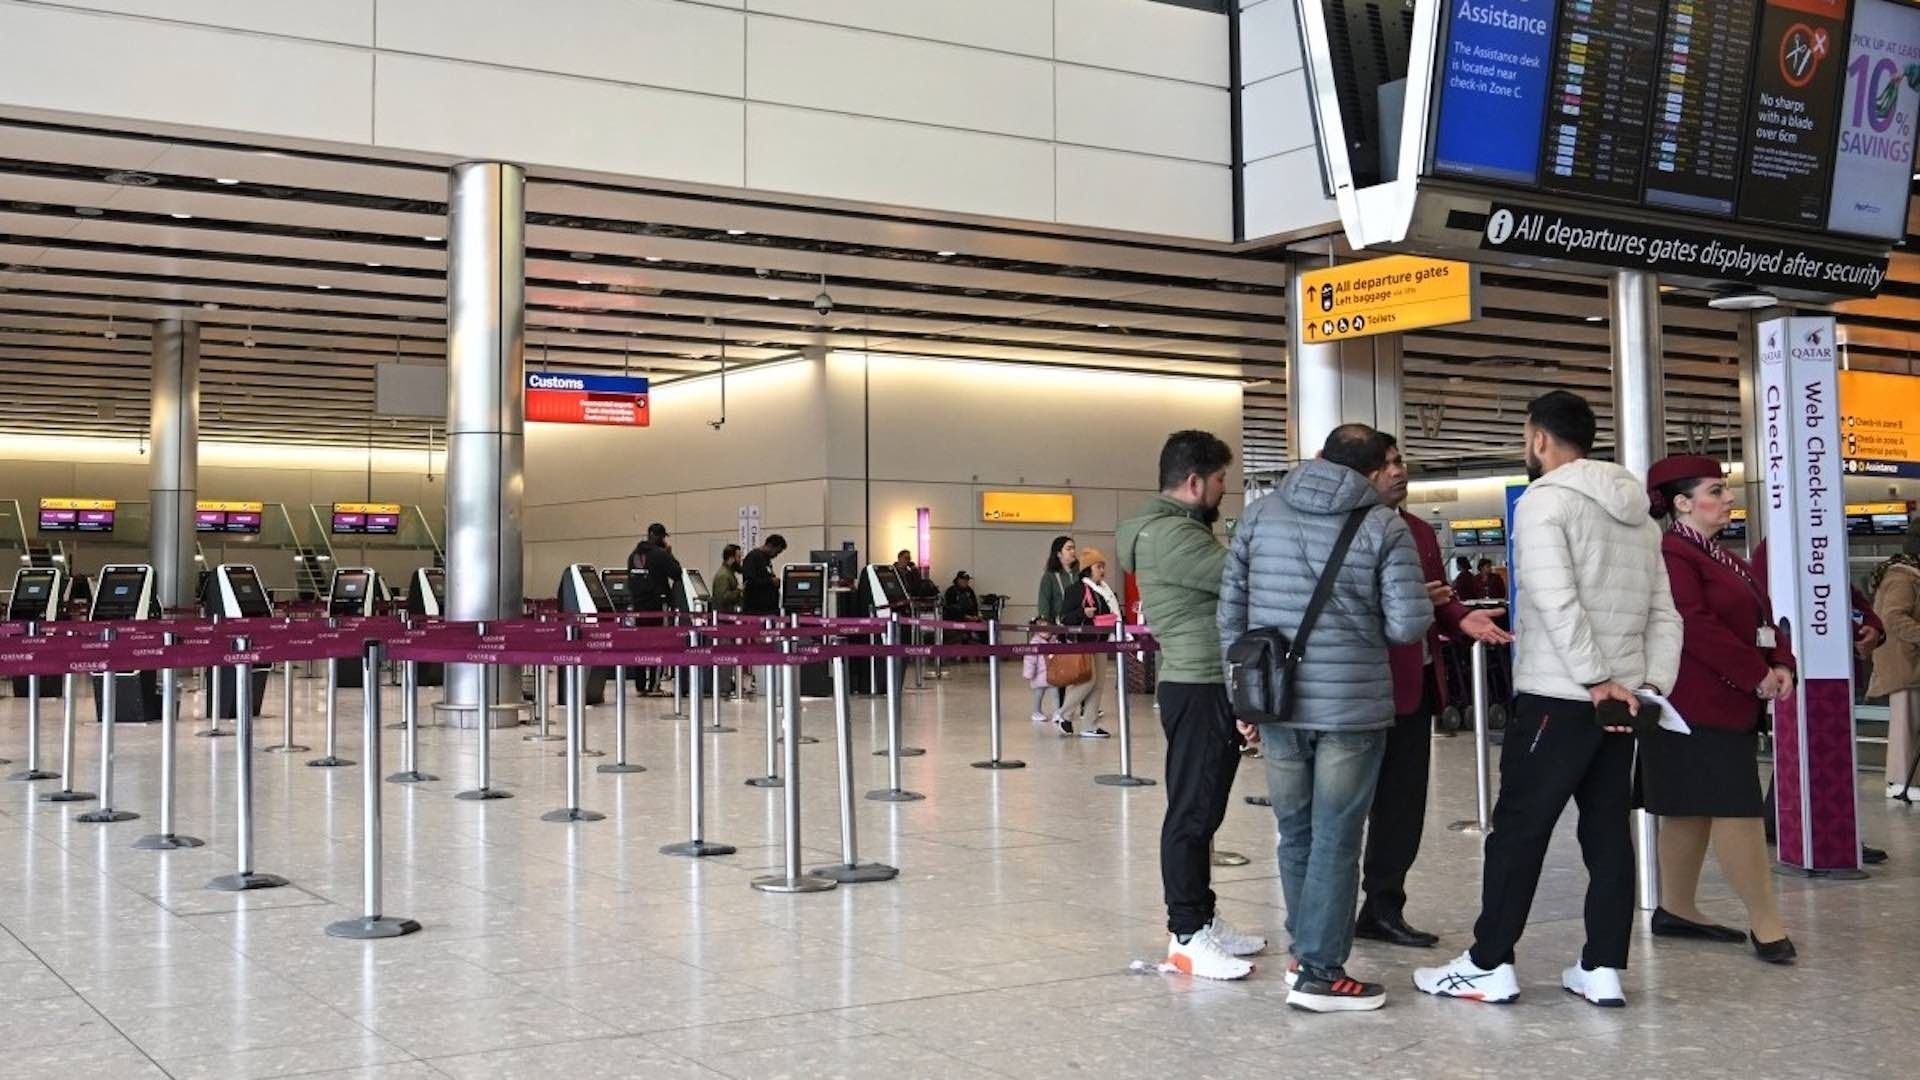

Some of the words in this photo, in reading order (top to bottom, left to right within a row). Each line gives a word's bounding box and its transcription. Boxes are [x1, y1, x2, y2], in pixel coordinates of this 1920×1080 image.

[1458, 1, 1547, 35] Assistance
[1455, 41, 1471, 55] The
[1473, 46, 1518, 64] Assistance
[1520, 53, 1540, 68] desk
[1452, 59, 1459, 70] is
[1461, 60, 1495, 76] located
[1497, 68, 1517, 80] near
[1450, 75, 1487, 92] check-in
[1489, 82, 1512, 97] Zone
[1760, 93, 1773, 107] No
[1775, 96, 1805, 113] sharps
[1758, 110, 1779, 123] with
[1781, 116, 1787, 126] a
[1788, 114, 1814, 130] blade
[1756, 127, 1777, 140] over
[1778, 129, 1798, 142] 6cm
[1841, 131, 1910, 163] SAVINGS
[1514, 215, 1544, 241] All
[1545, 218, 1647, 255] departures
[1647, 238, 1698, 263] gates
[1700, 240, 1784, 276] displayed
[1783, 252, 1824, 278] after
[1823, 261, 1886, 291] security
[1335, 281, 1351, 294] All
[1353, 271, 1412, 291] departure
[1415, 266, 1449, 283] gates
[1335, 295, 1352, 306] Left
[1353, 290, 1392, 303] baggage
[1367, 313, 1396, 325] Toilets
[1792, 348, 1832, 359] QATAR
[529, 375, 584, 389] Customs
[1804, 381, 1825, 428] Web
[1767, 385, 1785, 509] Check-in
[1865, 461, 1898, 472] Assistance
[1807, 436, 1828, 527] Check-in
[1808, 535, 1829, 576] Bag
[1811, 584, 1831, 636] Drop
